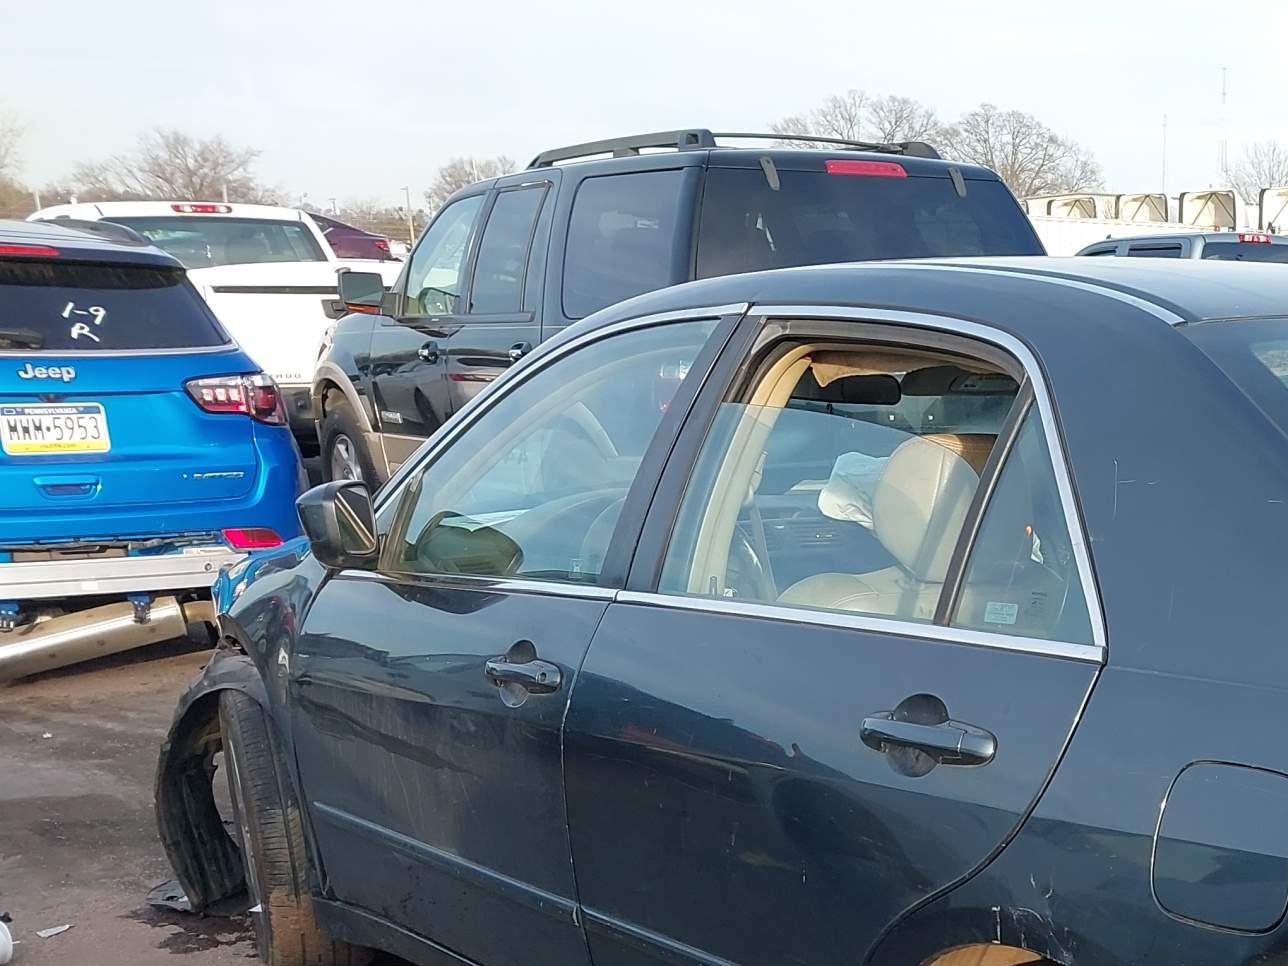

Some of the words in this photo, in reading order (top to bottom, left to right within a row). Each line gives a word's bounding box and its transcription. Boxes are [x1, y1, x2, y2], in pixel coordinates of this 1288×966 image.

[61, 302, 106, 325] 1-9
[70, 323, 100, 342] R
[18, 363, 76, 382] Jeep
